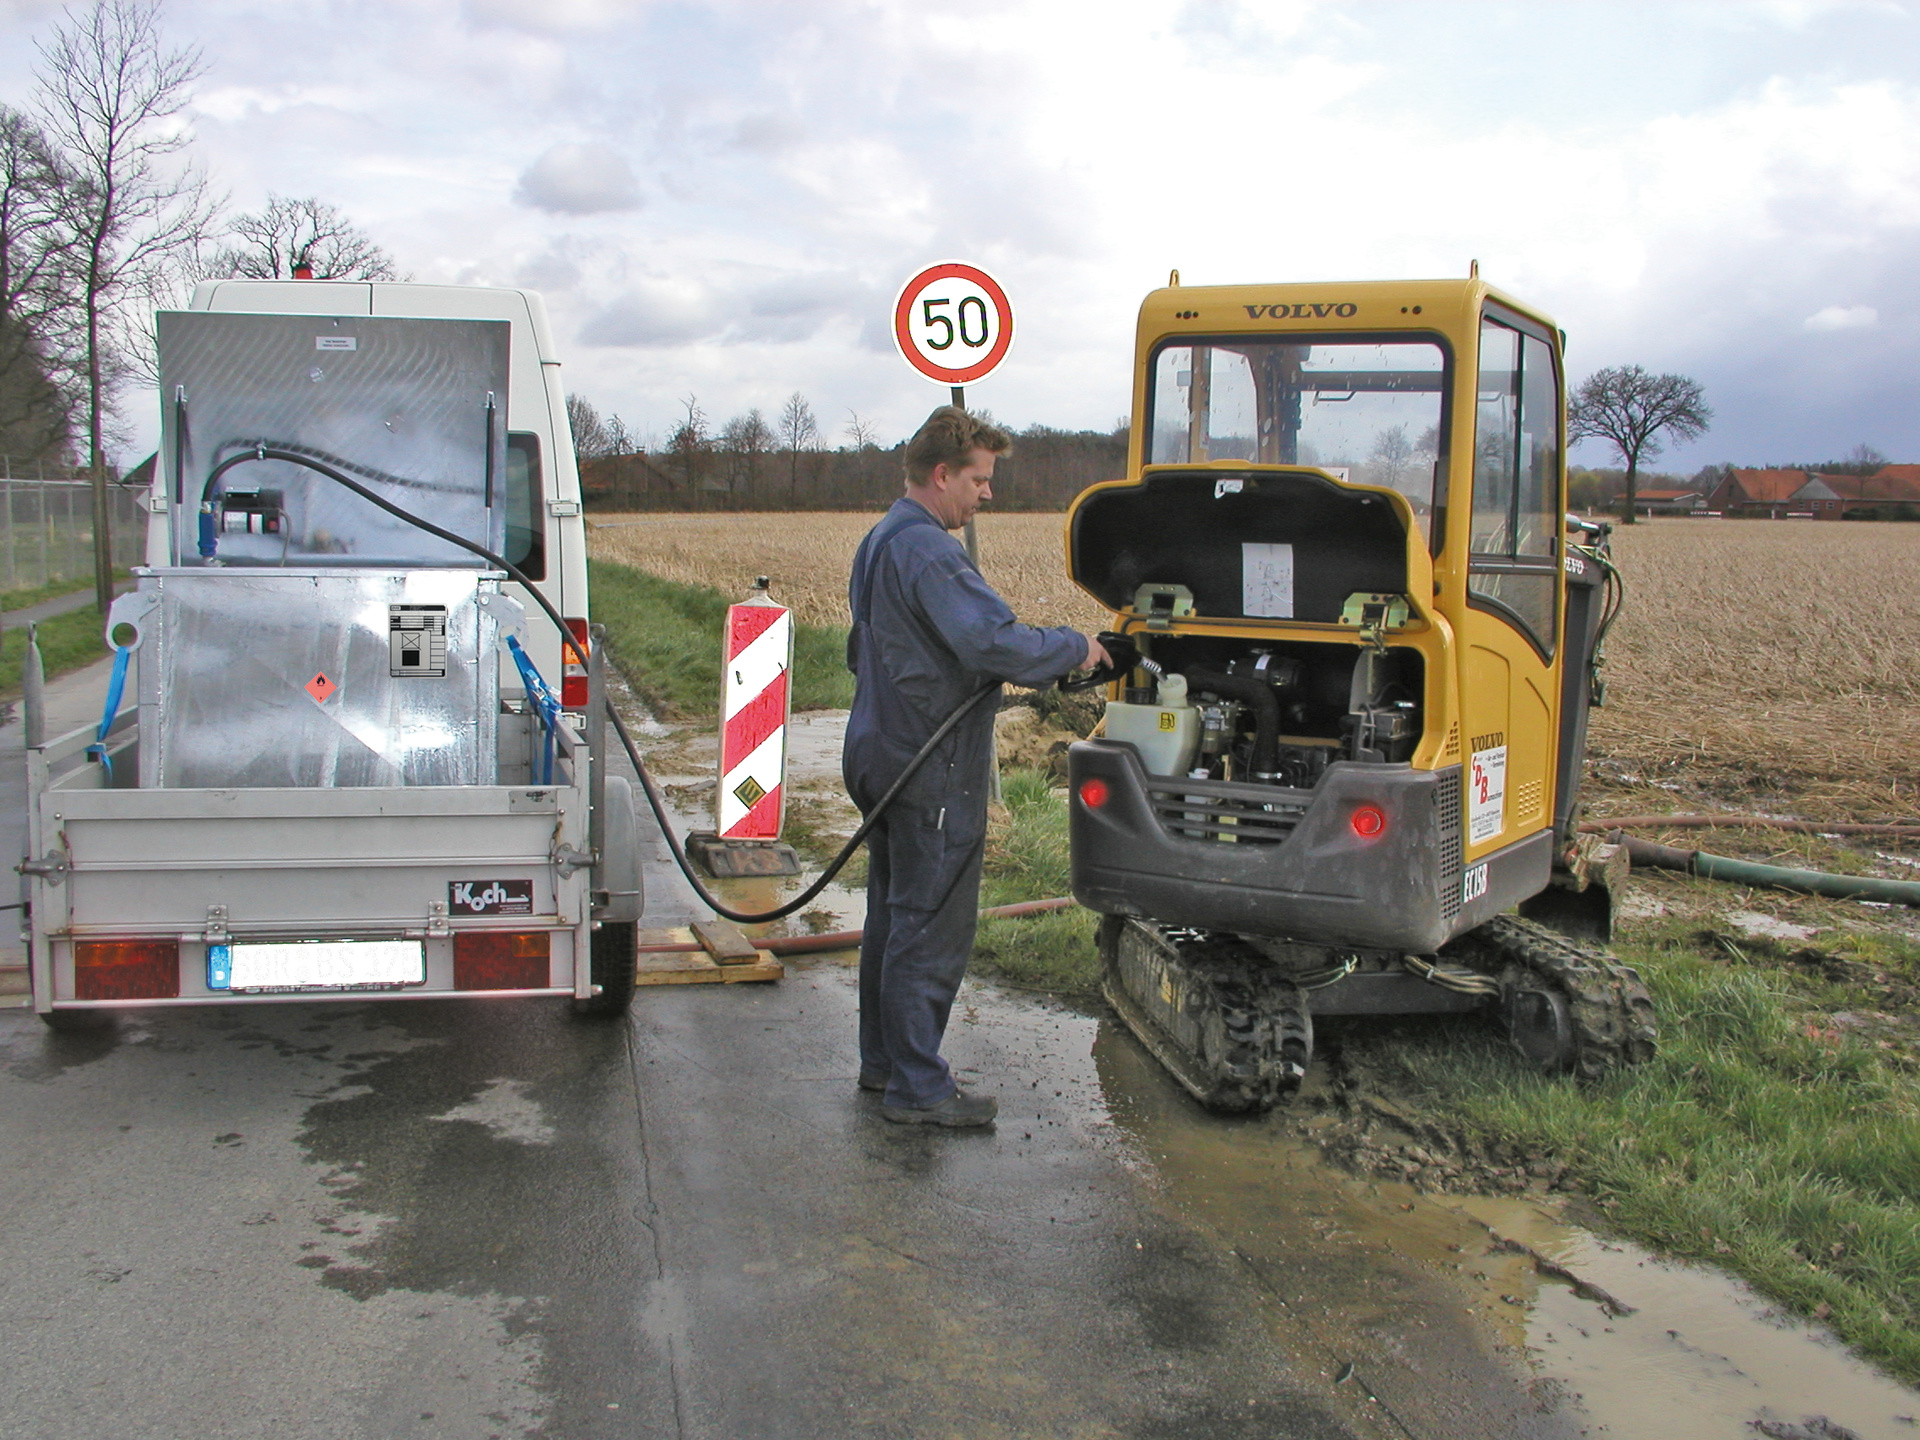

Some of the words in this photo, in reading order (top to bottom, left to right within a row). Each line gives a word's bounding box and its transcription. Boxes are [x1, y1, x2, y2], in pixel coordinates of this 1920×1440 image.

[923, 296, 988, 351] 50
[1242, 303, 1358, 319] VOLVO
[1470, 731, 1504, 753] VOLVO
[454, 882, 507, 911] Koch
[1464, 863, 1488, 903] EC15B
